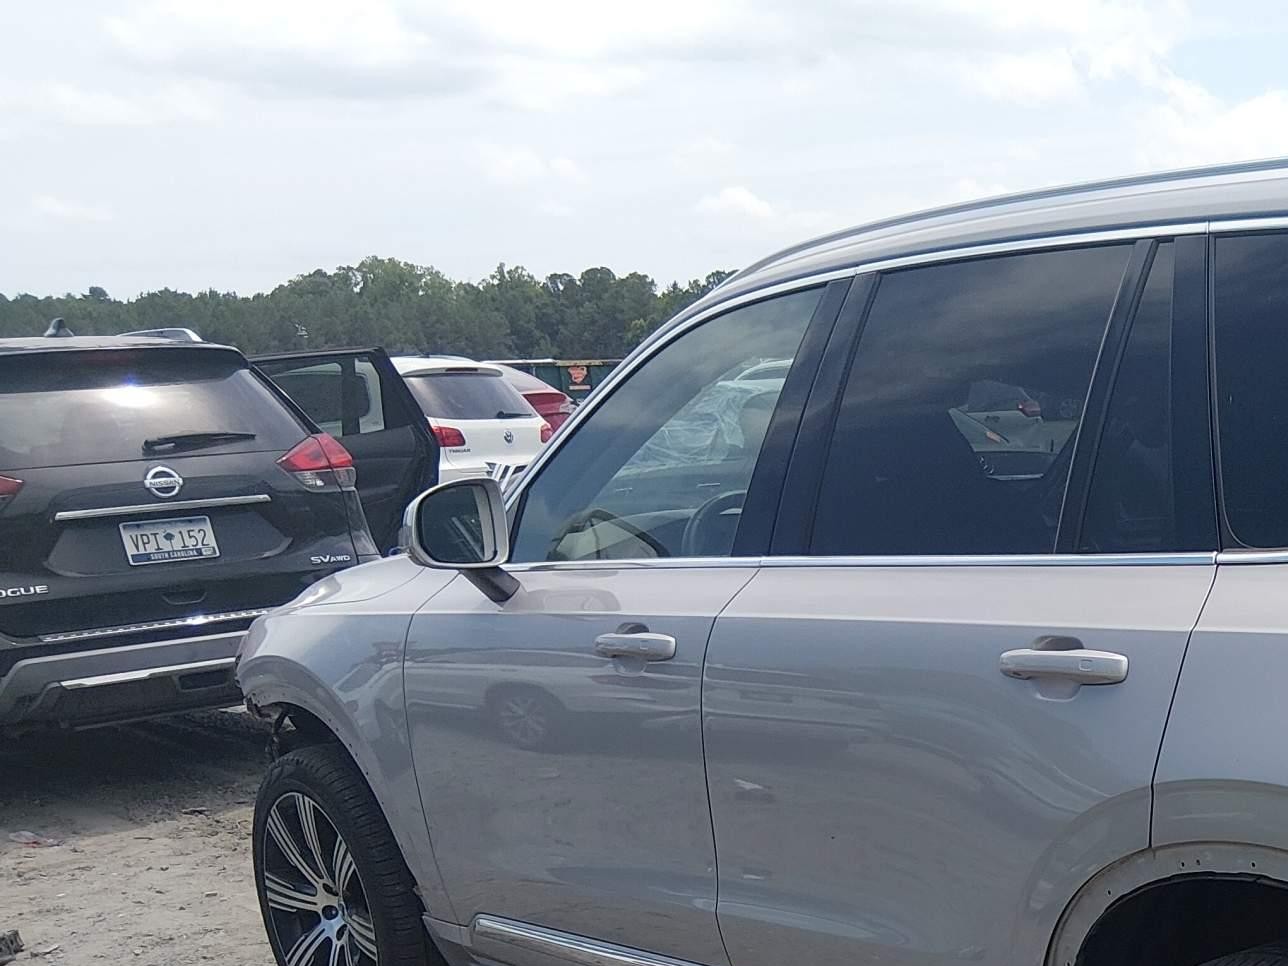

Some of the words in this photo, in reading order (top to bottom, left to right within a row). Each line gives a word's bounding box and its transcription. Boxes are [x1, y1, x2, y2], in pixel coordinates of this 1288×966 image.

[149, 479, 180, 487] NISSAN
[129, 532, 164, 553] VPI
[178, 528, 211, 549] 152
[150, 552, 170, 560] SOUTH
[170, 550, 199, 558] CAROLINA
